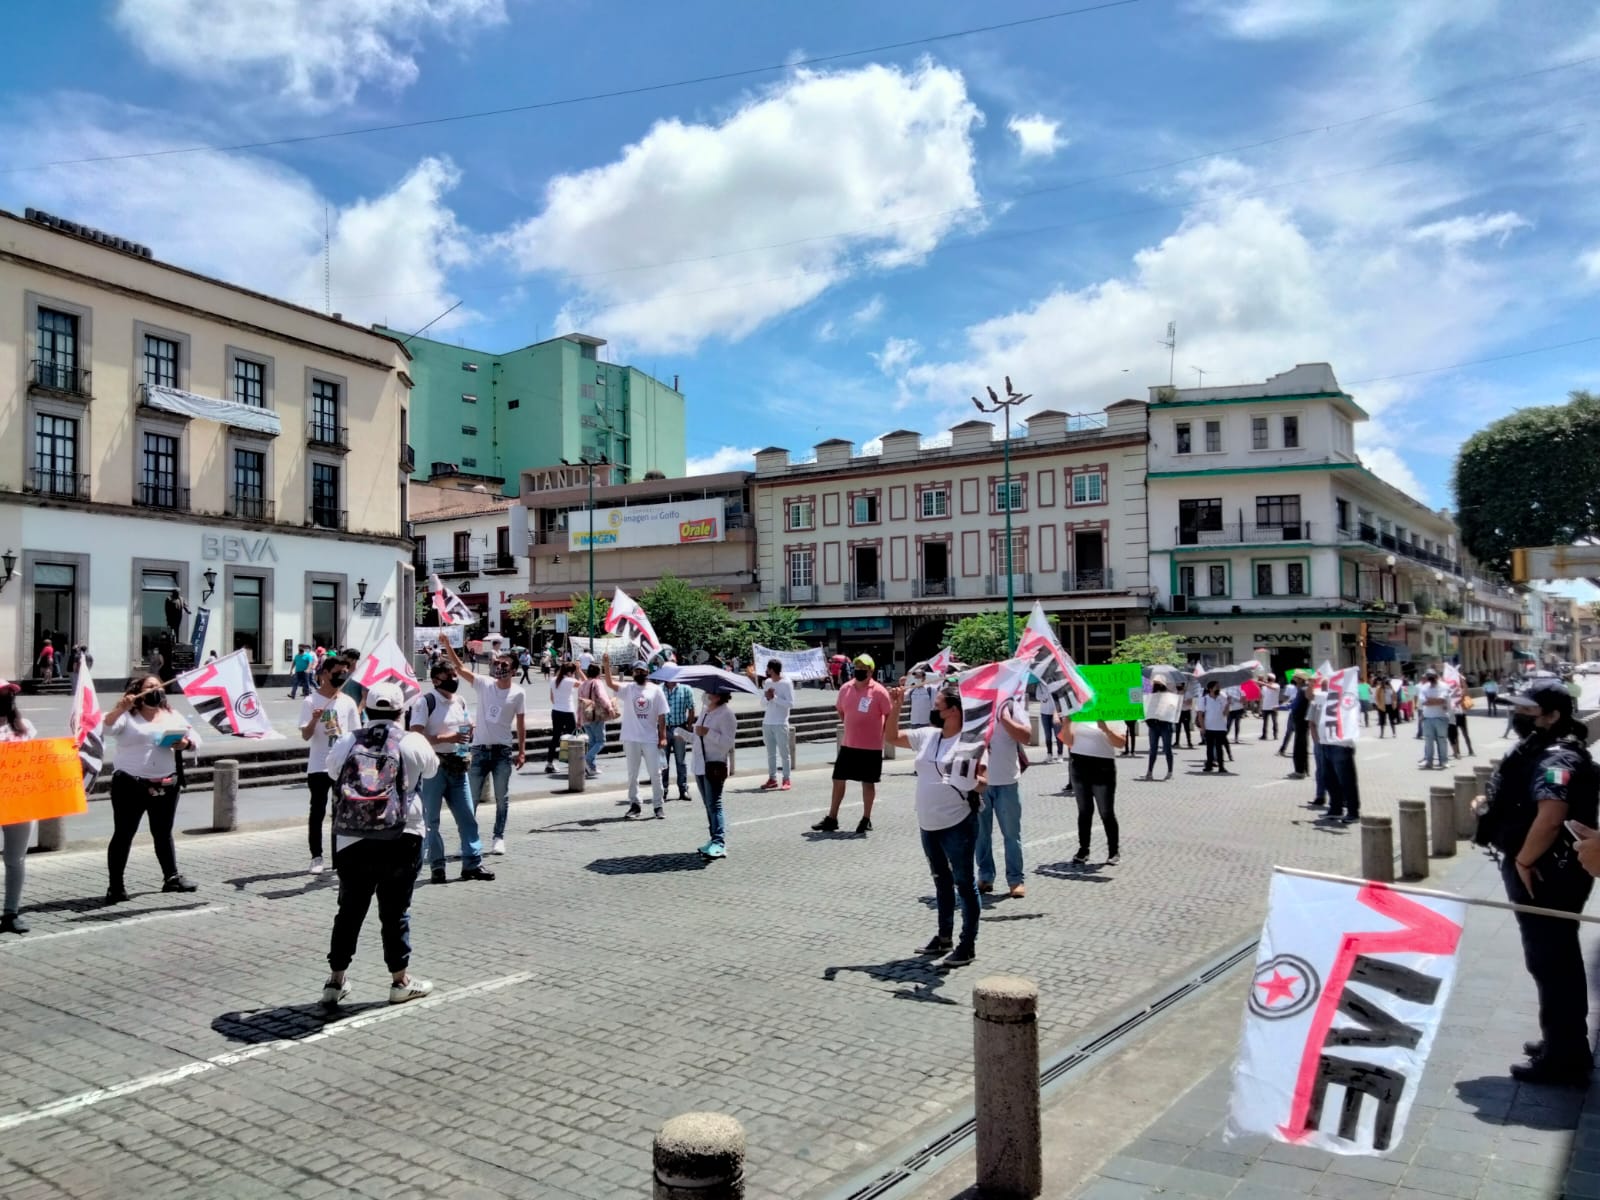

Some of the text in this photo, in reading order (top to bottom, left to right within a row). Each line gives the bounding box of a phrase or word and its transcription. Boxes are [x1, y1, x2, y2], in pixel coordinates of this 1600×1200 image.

[202, 533, 279, 562] BBVA
[1177, 634, 1233, 645] DEVLYN
[1253, 633, 1312, 643] DEVLYN
